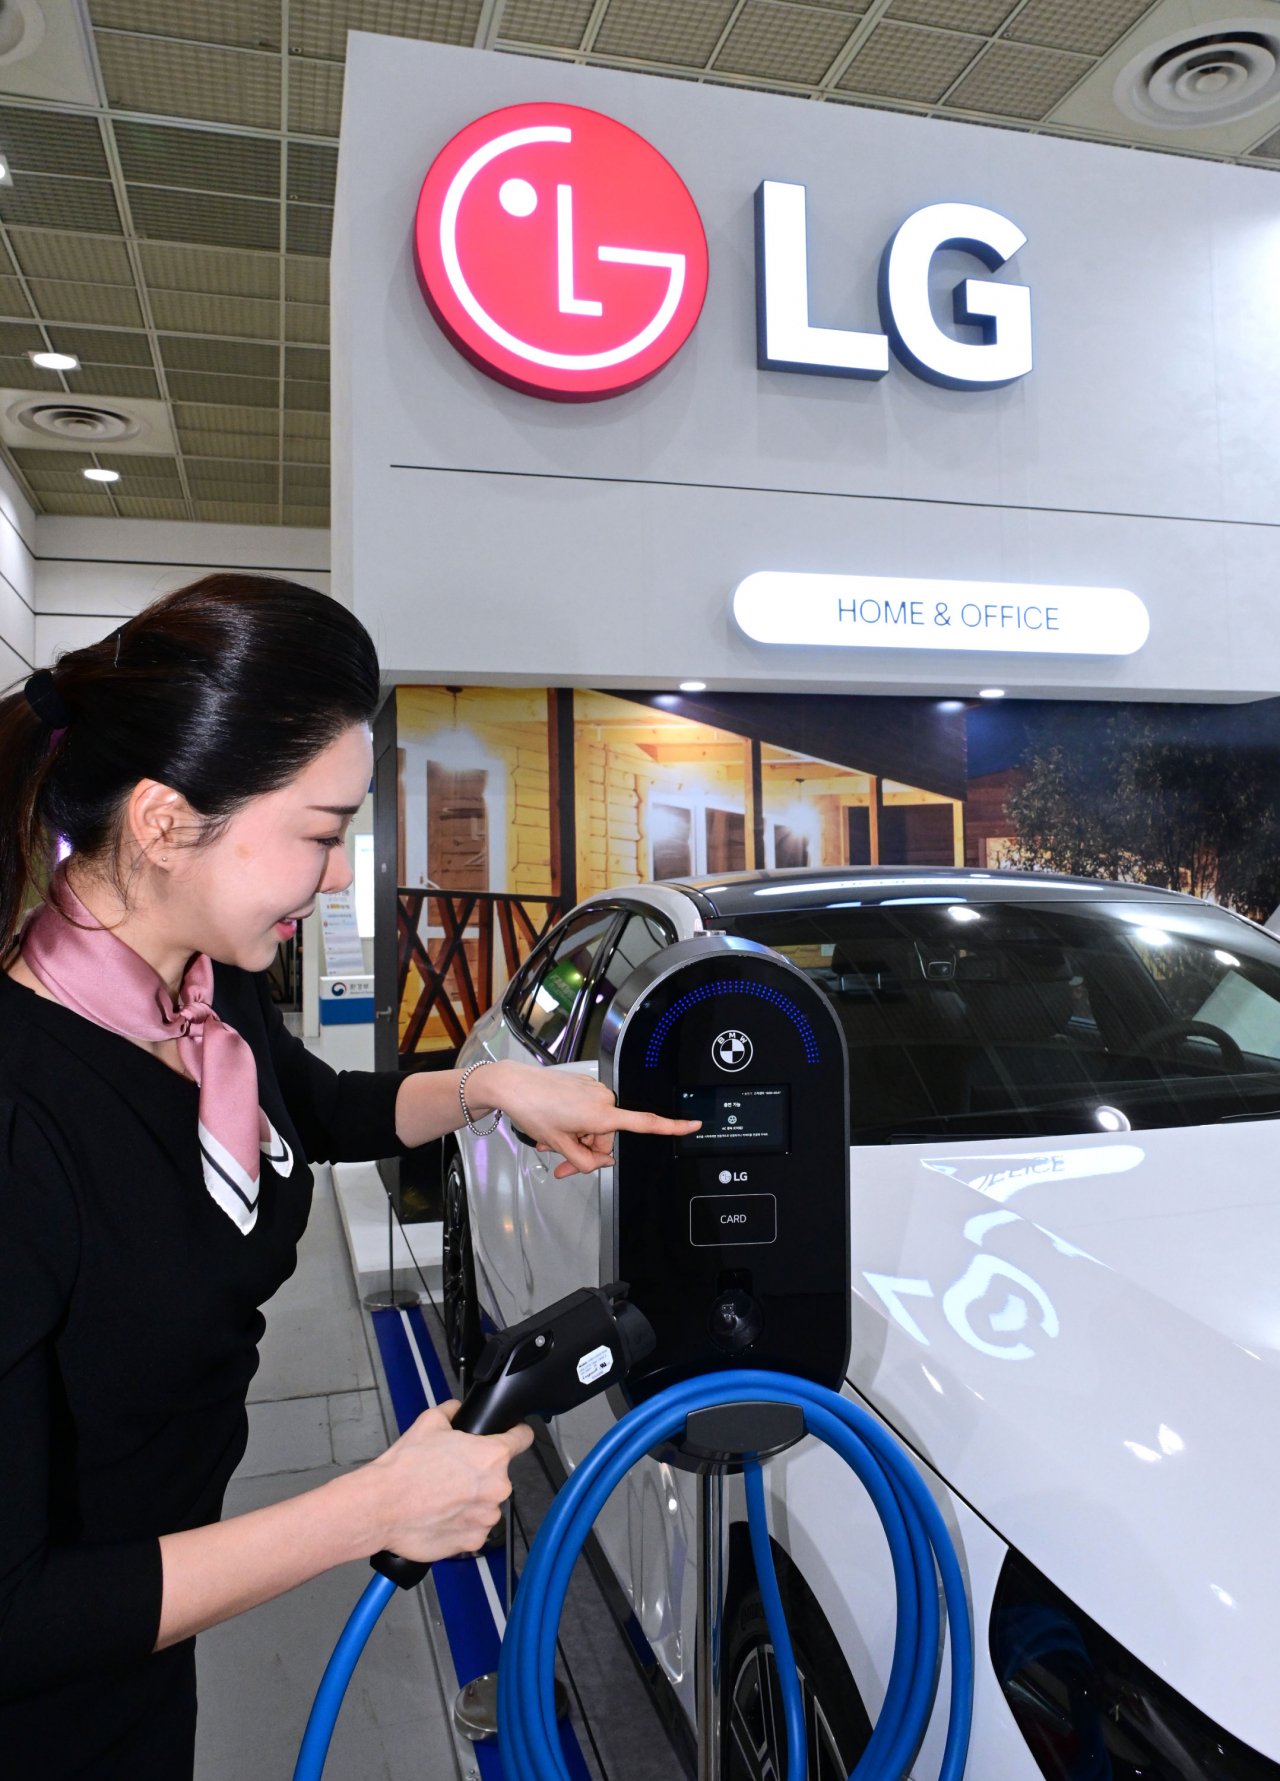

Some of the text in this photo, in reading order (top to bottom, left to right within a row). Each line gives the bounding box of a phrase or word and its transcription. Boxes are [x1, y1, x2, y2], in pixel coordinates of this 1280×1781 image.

[756, 179, 1033, 390] LG
[838, 598, 1060, 630] HOME & OFFICE
[717, 1032, 748, 1044] BMW
[733, 1171, 748, 1182] LG
[720, 1214, 747, 1224] CARD
